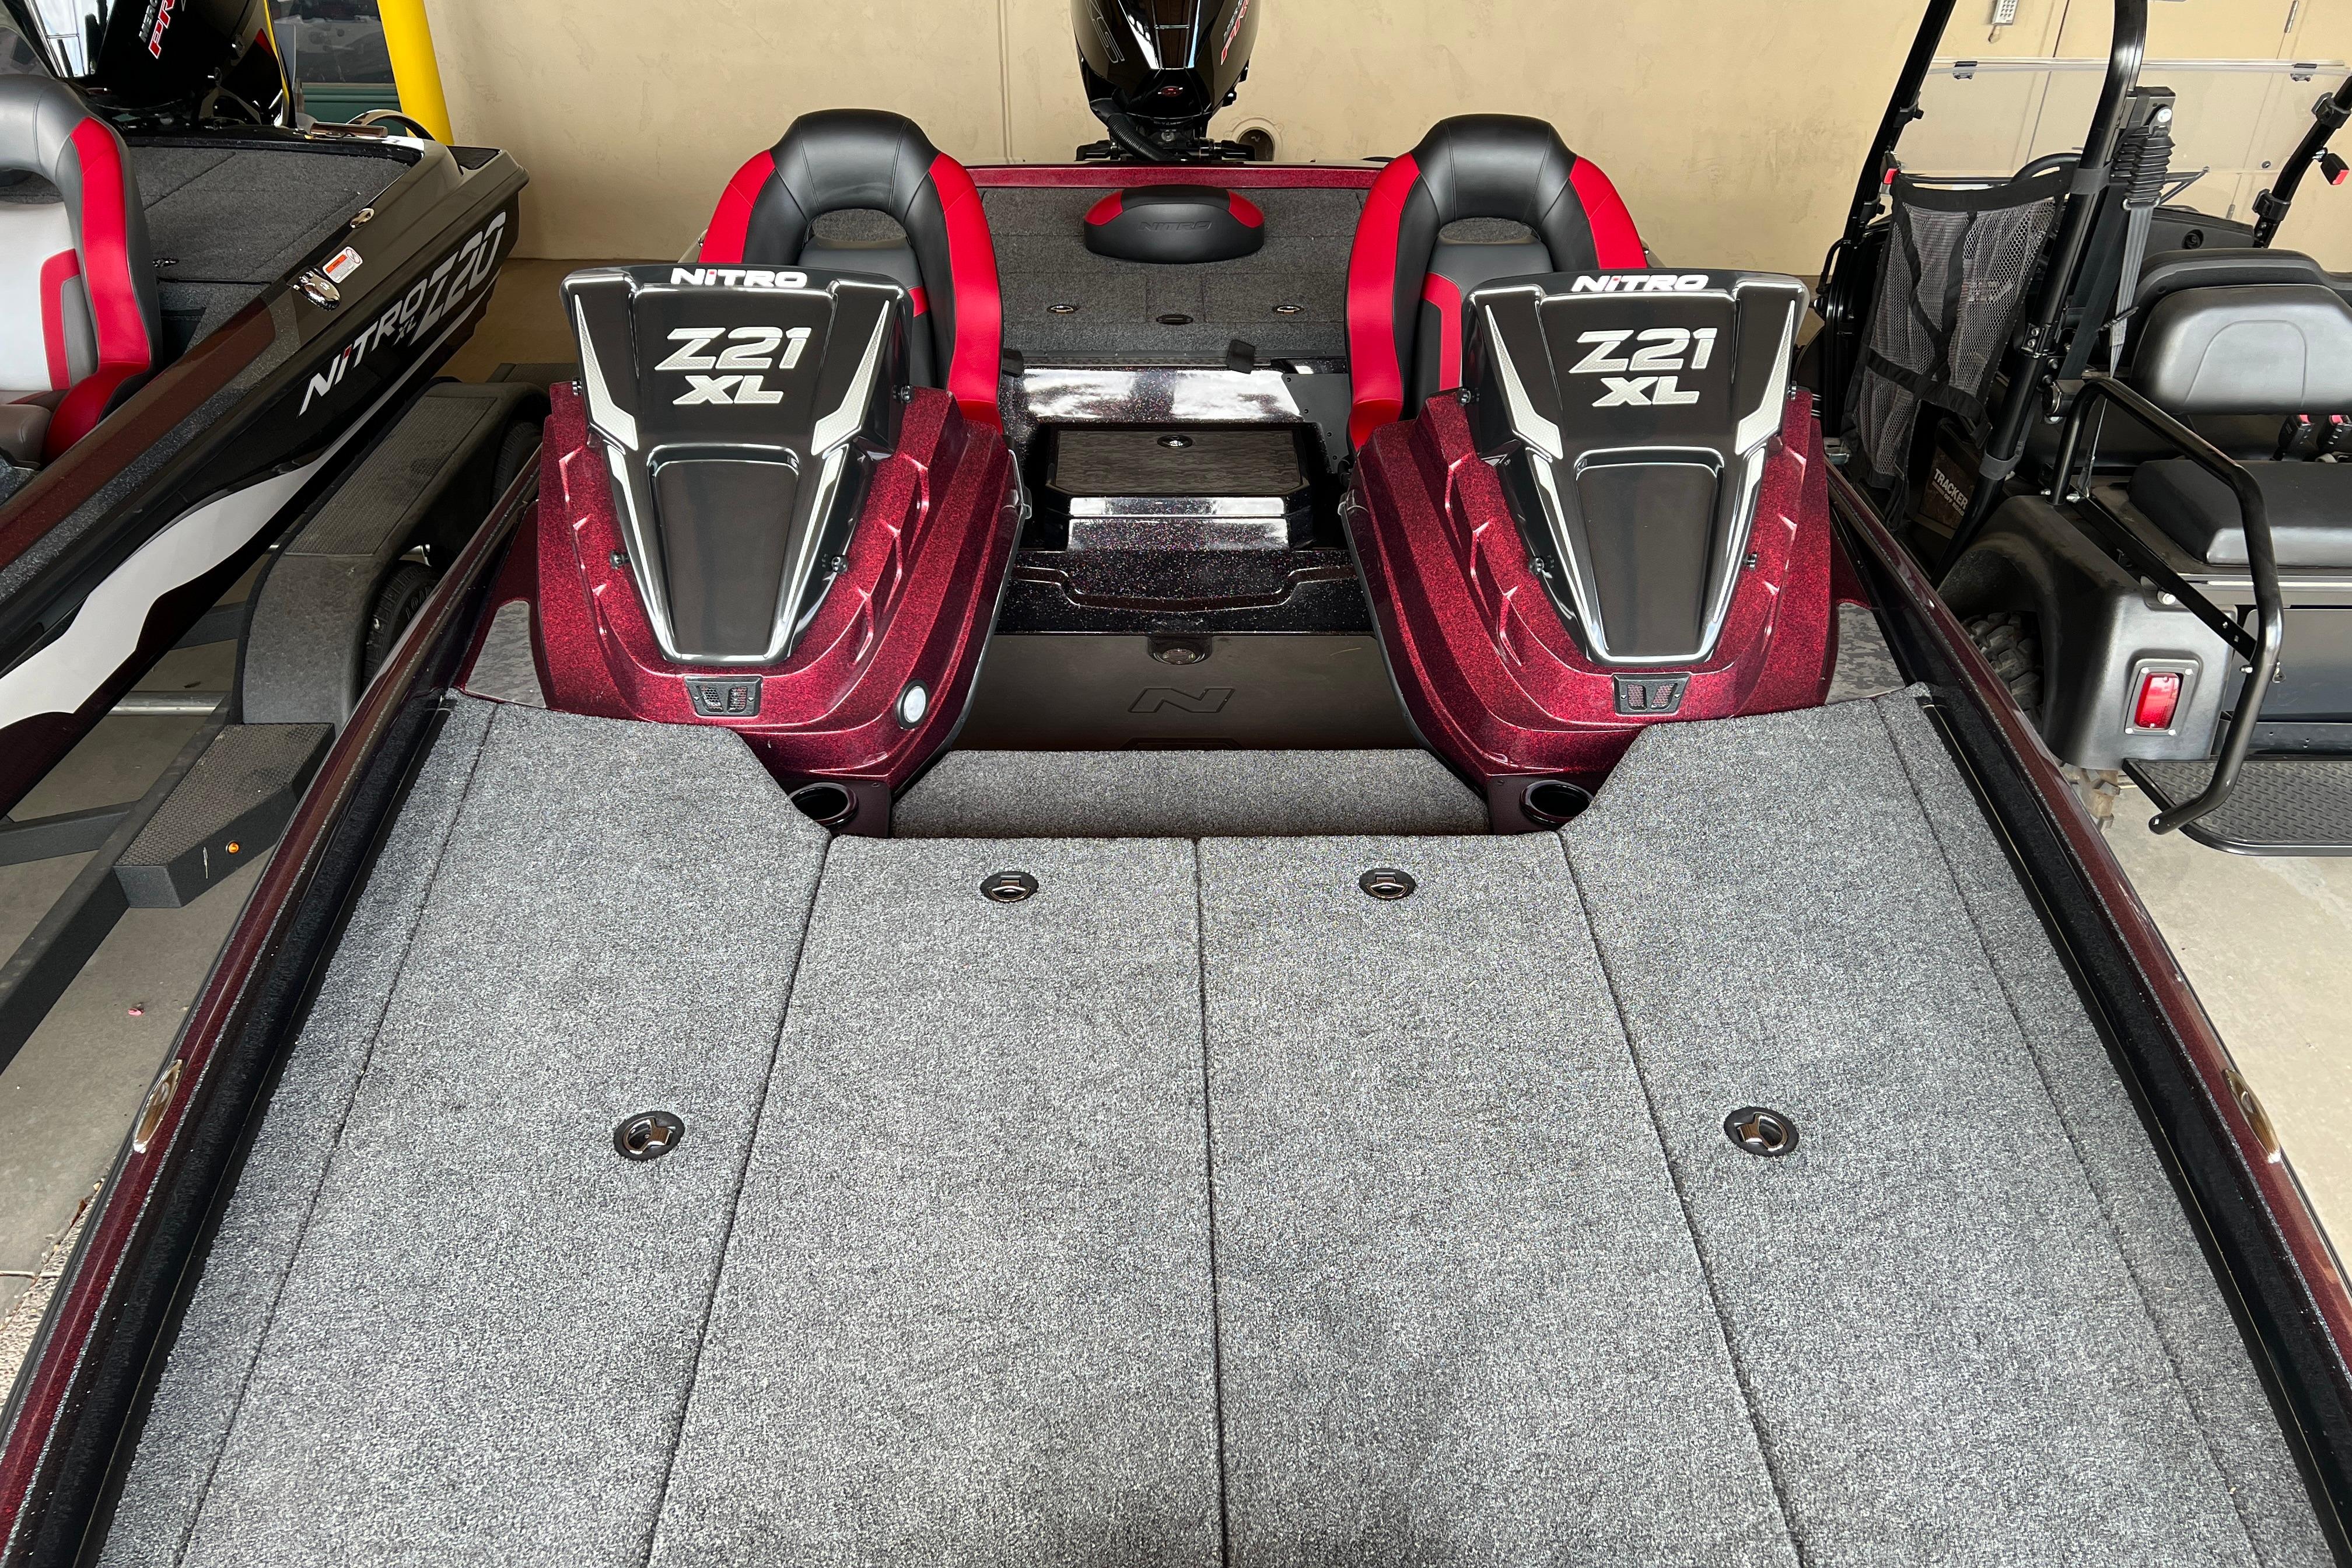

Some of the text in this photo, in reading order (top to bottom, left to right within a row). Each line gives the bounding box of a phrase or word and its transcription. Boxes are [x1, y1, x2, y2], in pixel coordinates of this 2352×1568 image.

[1138, 220, 1212, 232] NITRO
[670, 268, 808, 288] NITRO
[1570, 274, 1709, 292] NITRO
[296, 211, 506, 419] NITRO Z20
[393, 316, 417, 346] XL
[654, 326, 812, 370] Z21
[1568, 327, 1718, 374] Z21
[672, 375, 784, 405] XL
[1591, 376, 1700, 407] XL
[1934, 468, 1968, 510] TRACKER
[1944, 493, 1953, 503] OFF
